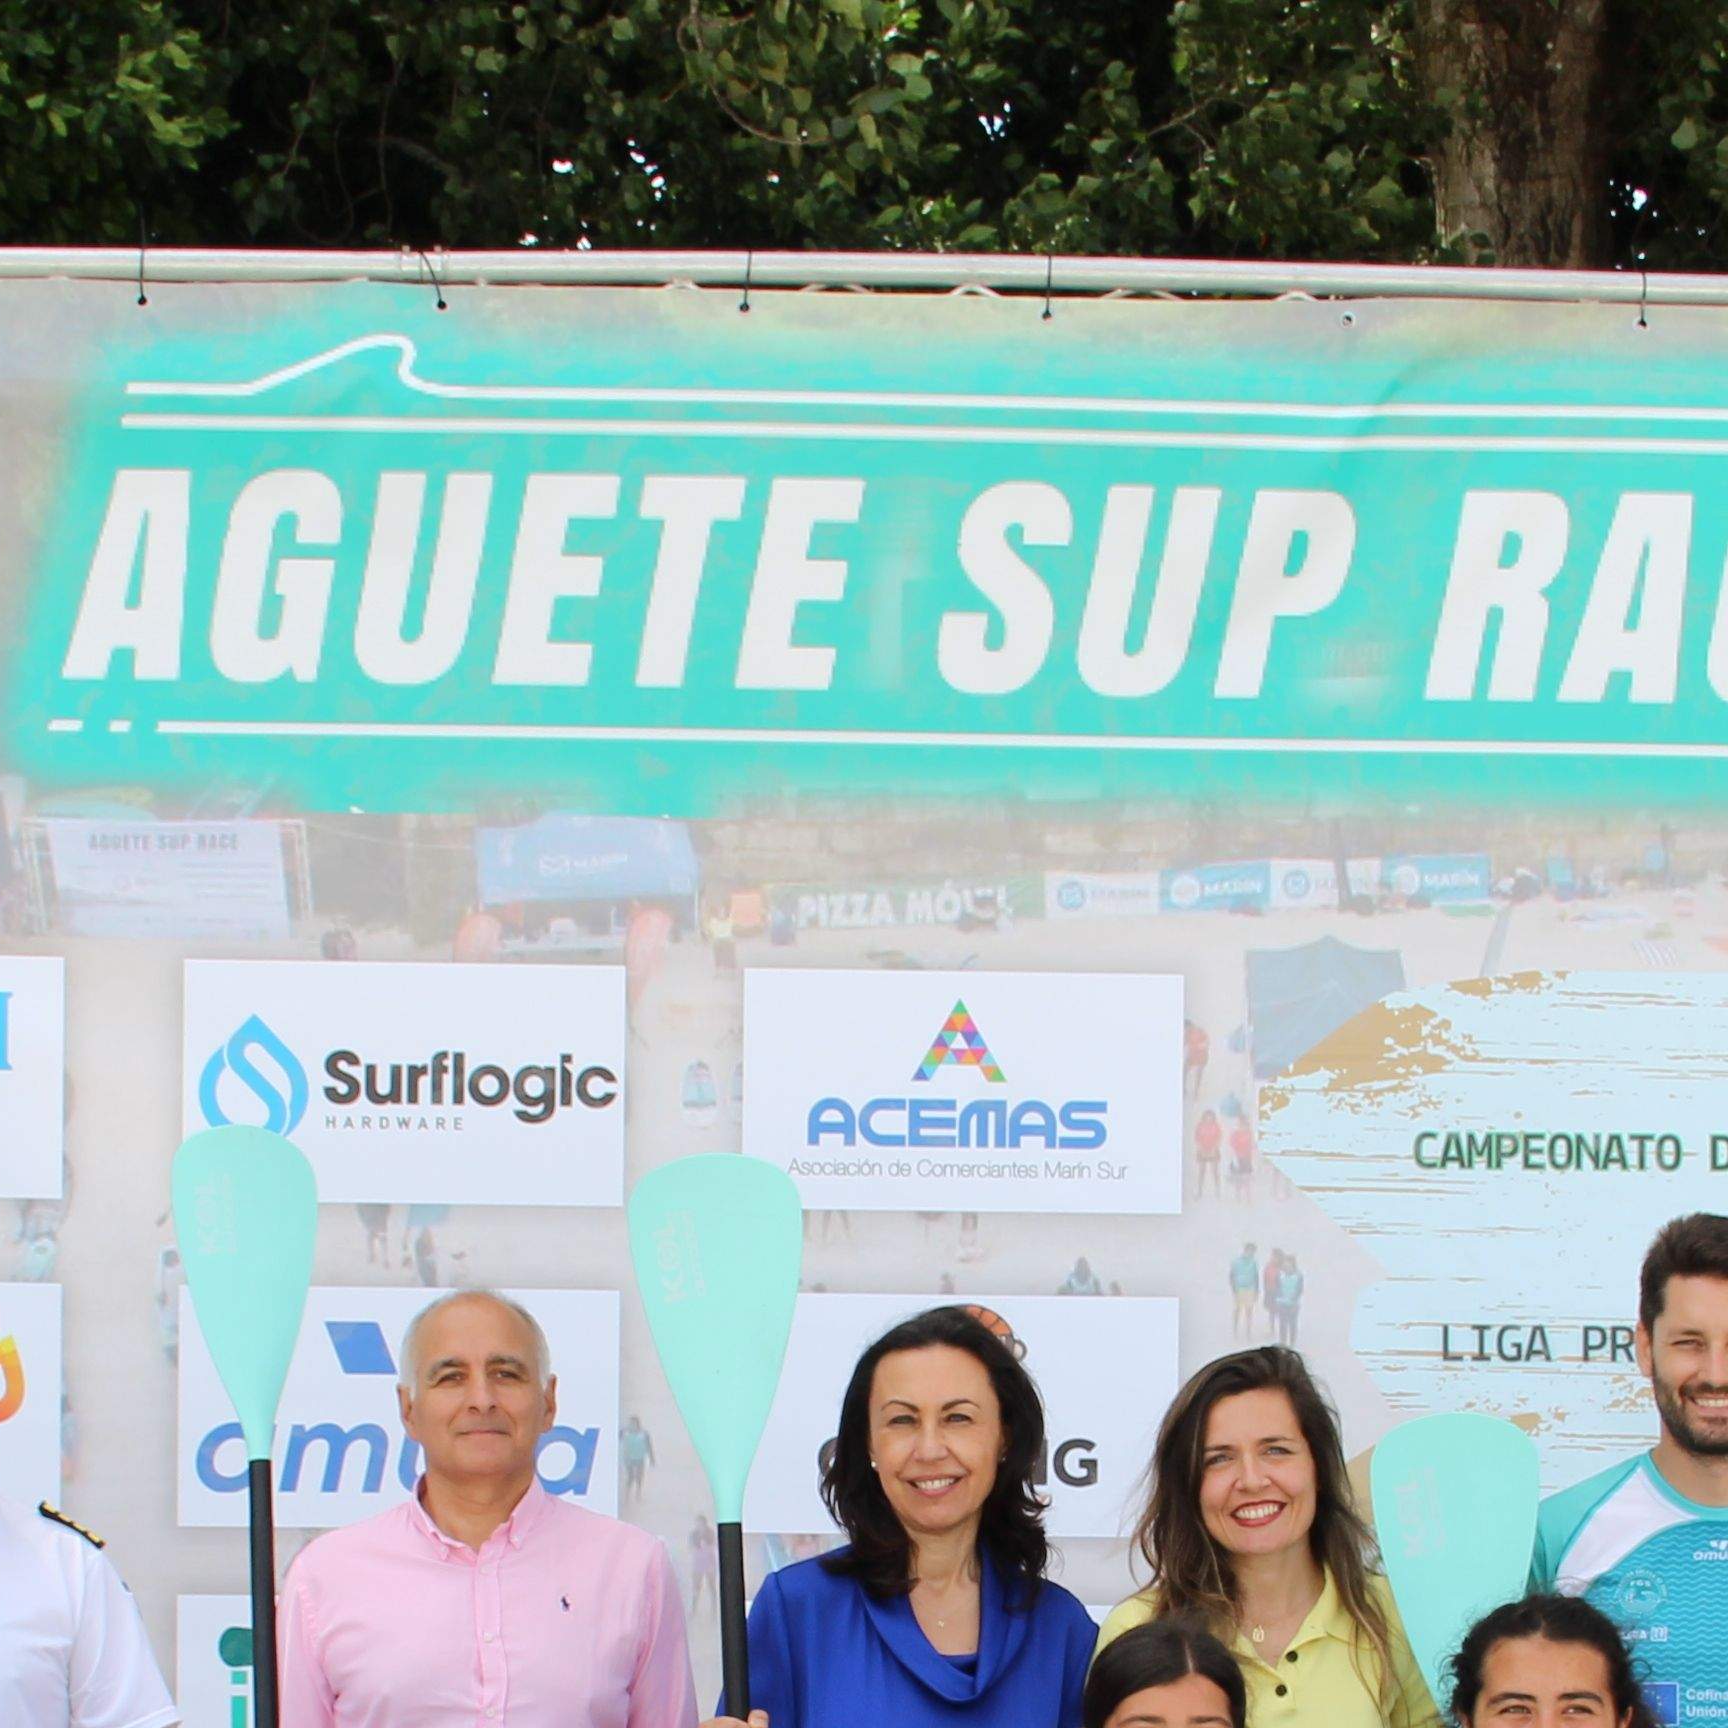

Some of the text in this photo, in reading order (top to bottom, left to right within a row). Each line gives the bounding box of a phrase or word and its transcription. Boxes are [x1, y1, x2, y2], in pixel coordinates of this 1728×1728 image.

[60, 468, 866, 693] AGUETE
[936, 481, 1357, 701] SUP
[798, 892, 896, 929] PIZZA
[323, 1049, 618, 1124] Surflogic
[325, 1115, 465, 1131] HARDWARE
[806, 1096, 1108, 1150] ACEMAS
[787, 1157, 1128, 1180] Asociación de Comerciantes Marín Sur
[1413, 1129, 1683, 1172] CAMPEONATO
[1441, 1323, 1553, 1364] LIGA
[196, 1422, 601, 1496] ama
[1685, 1705, 1728, 1719] Unión
